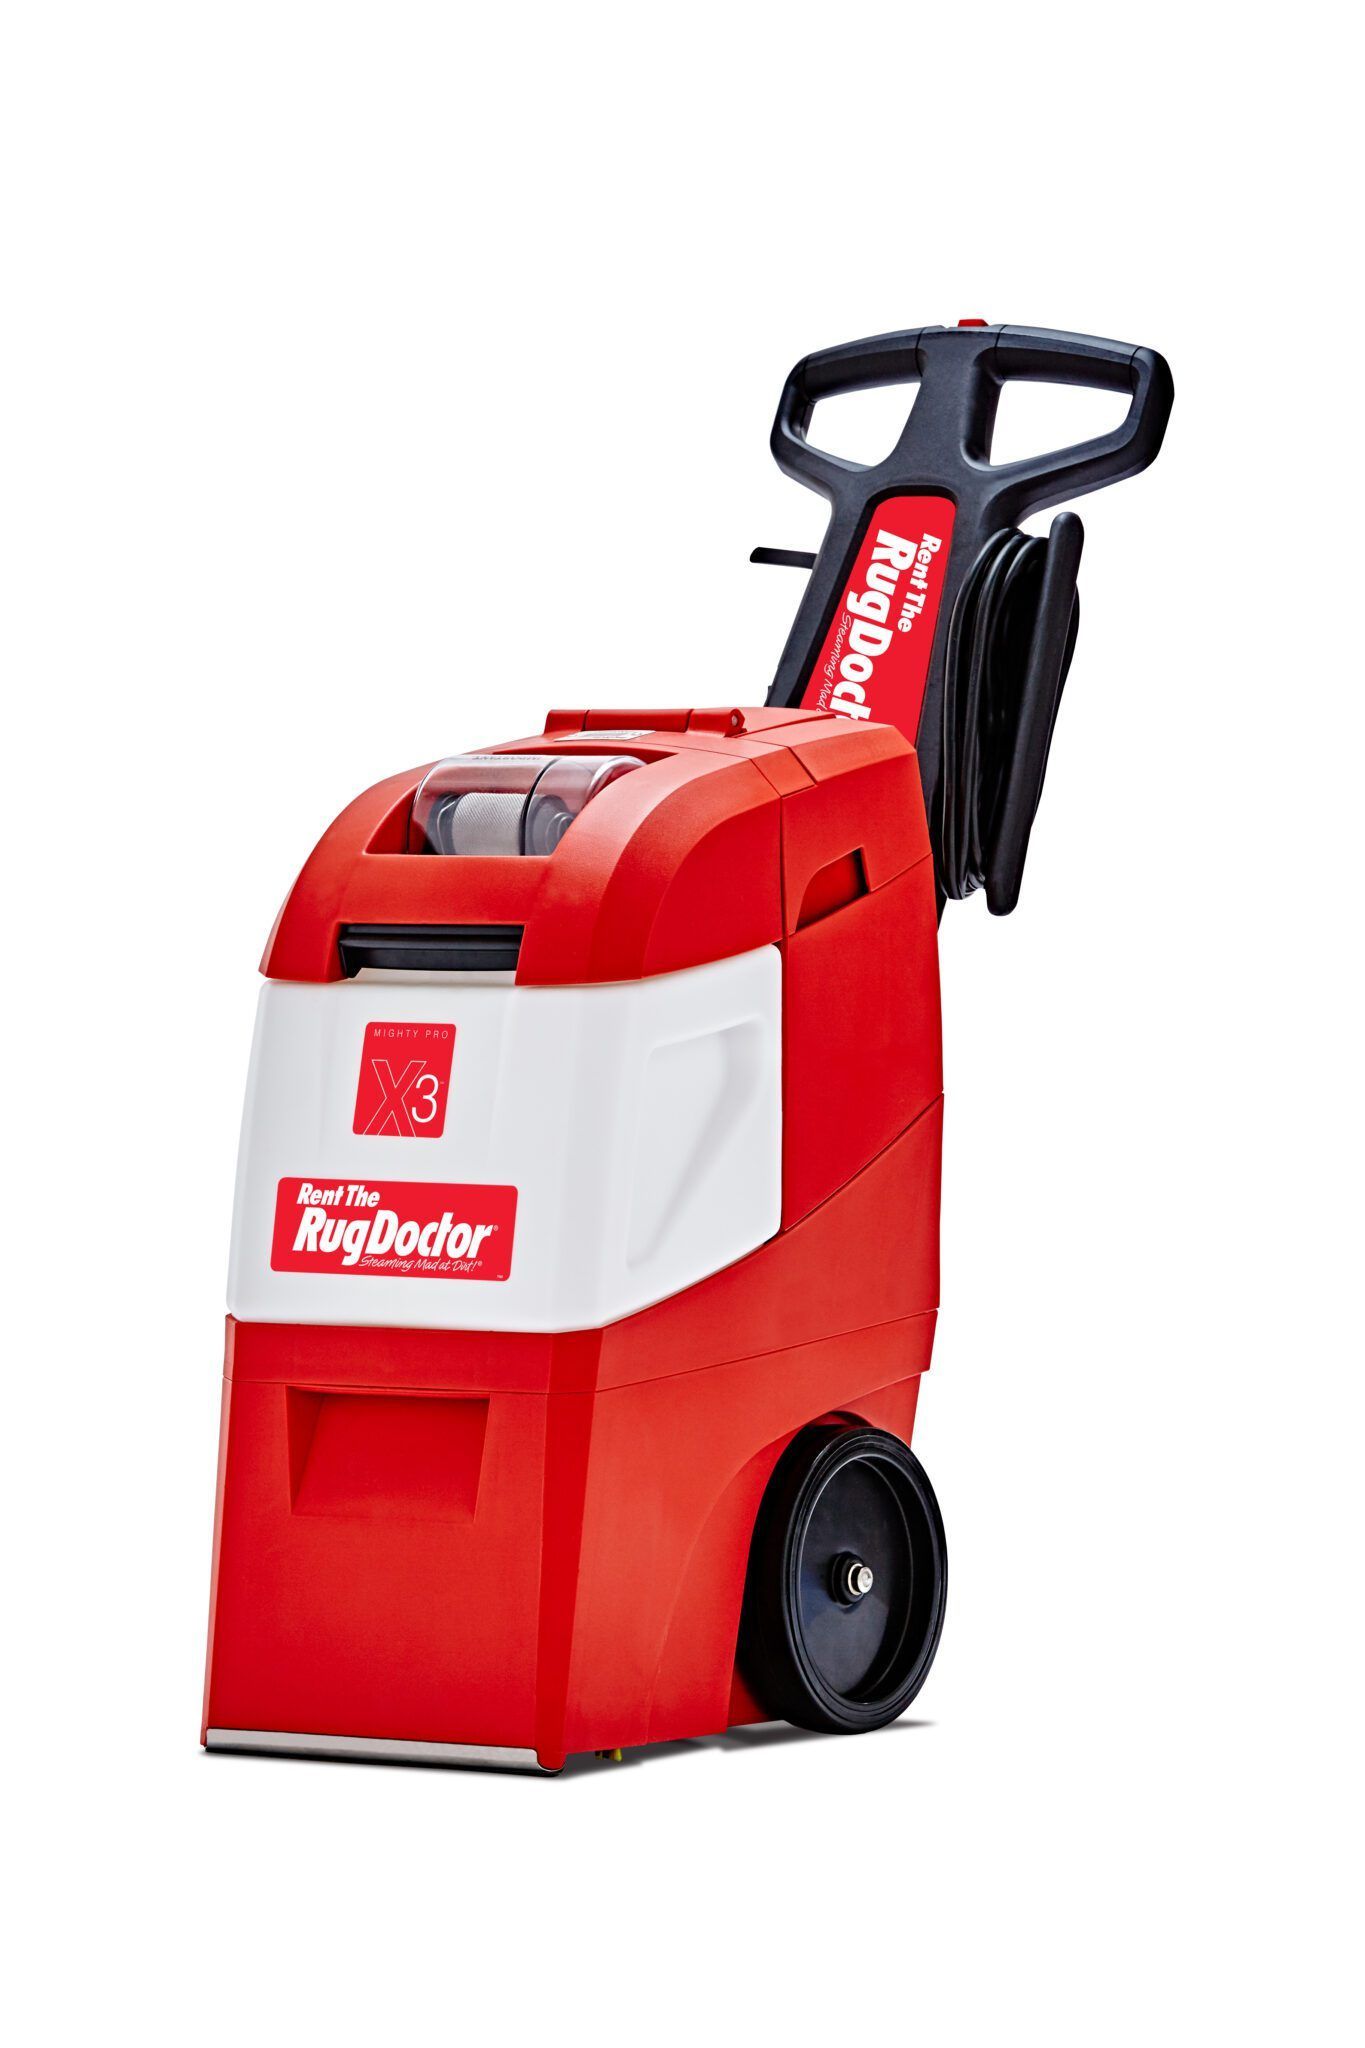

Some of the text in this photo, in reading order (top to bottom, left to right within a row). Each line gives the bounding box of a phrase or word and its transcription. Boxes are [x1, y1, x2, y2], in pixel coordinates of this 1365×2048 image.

[898, 533, 943, 633] Rent The
[829, 529, 918, 720] RugDoct
[816, 612, 852, 711] Steaming Mad
[373, 1028, 449, 1040] MIGHTY PRO
[296, 1182, 381, 1208] Rent The
[358, 1255, 412, 1273] Steaming
[413, 1259, 440, 1272] Mad
[437, 1260, 451, 1271] at
